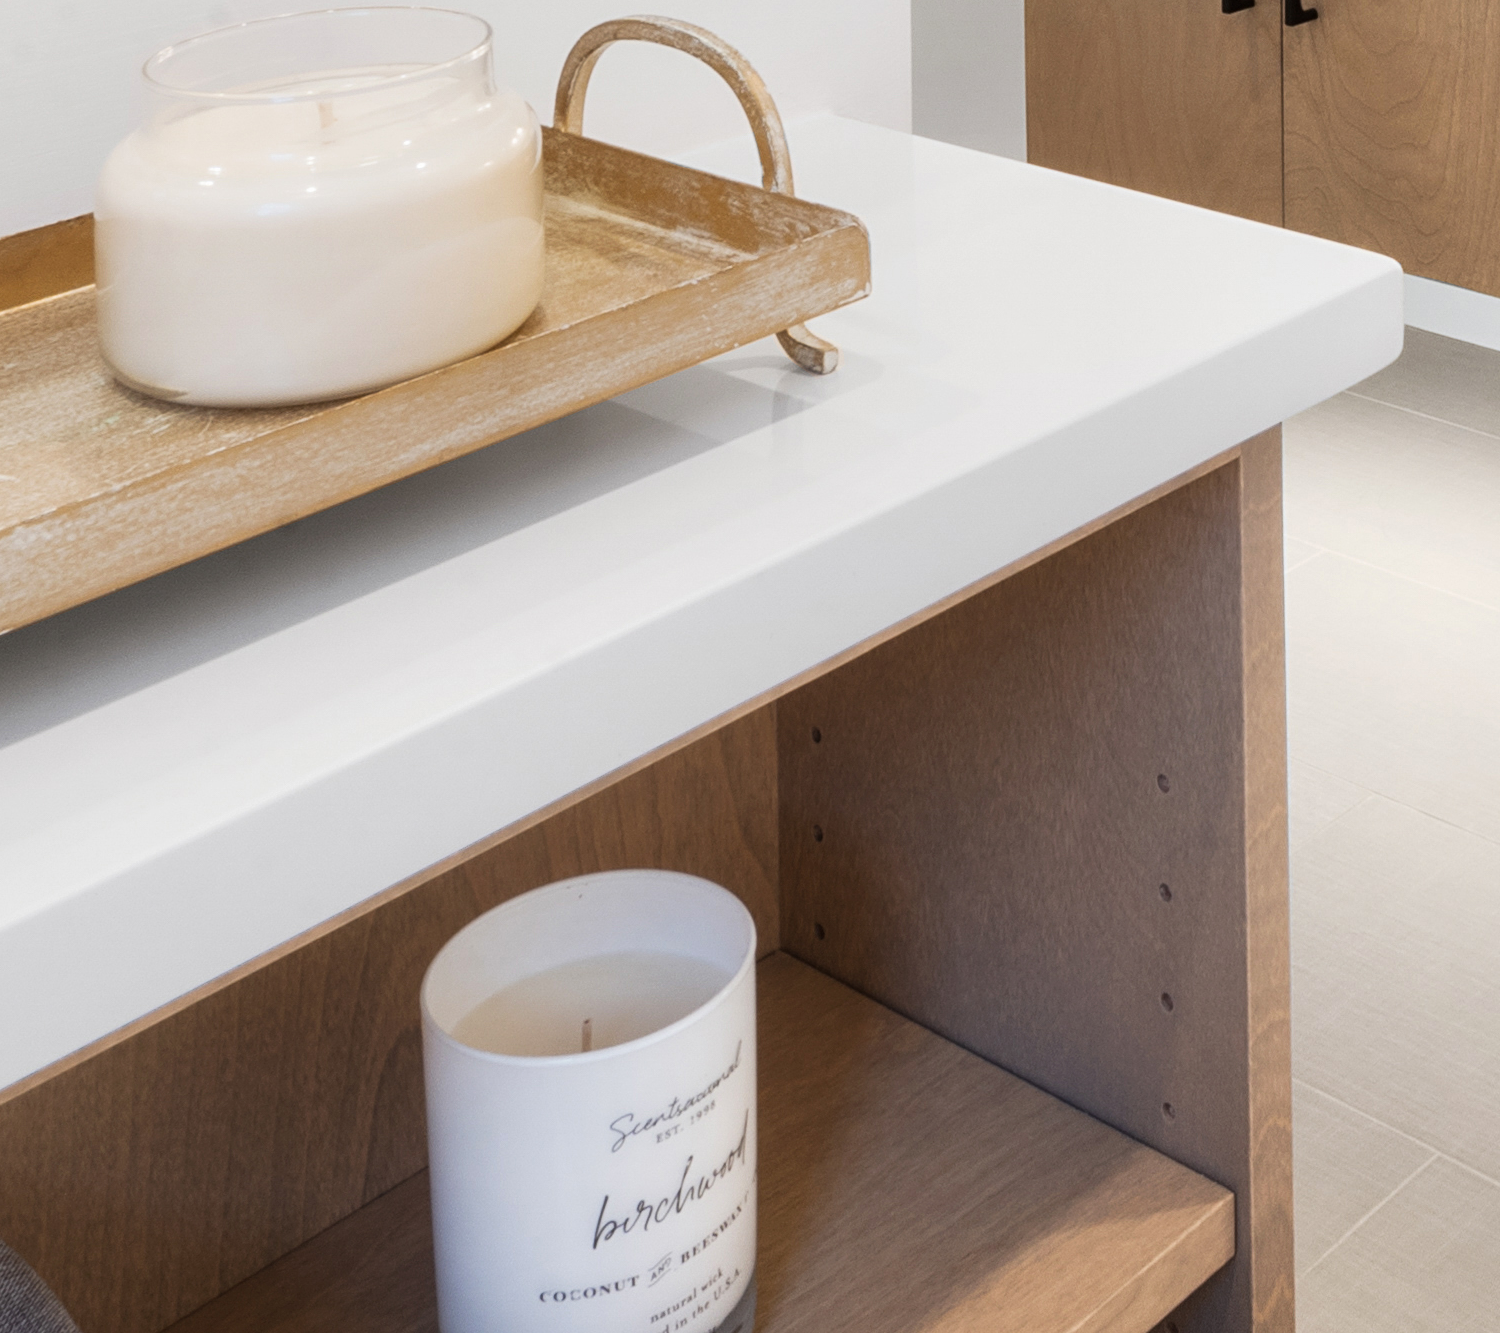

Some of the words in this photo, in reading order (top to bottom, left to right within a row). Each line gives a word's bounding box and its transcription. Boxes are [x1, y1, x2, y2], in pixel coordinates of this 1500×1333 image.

[656, 1124, 684, 1144] EST.
[592, 1107, 749, 1250] birchwood
[539, 1275, 640, 1303] COCONUT
[650, 1257, 672, 1282] AND
[680, 1202, 743, 1265] BEESWAX
[650, 1287, 697, 1324] natural
[700, 1268, 723, 1292] wick
[675, 1317, 688, 1331] in
[692, 1301, 710, 1319] the
